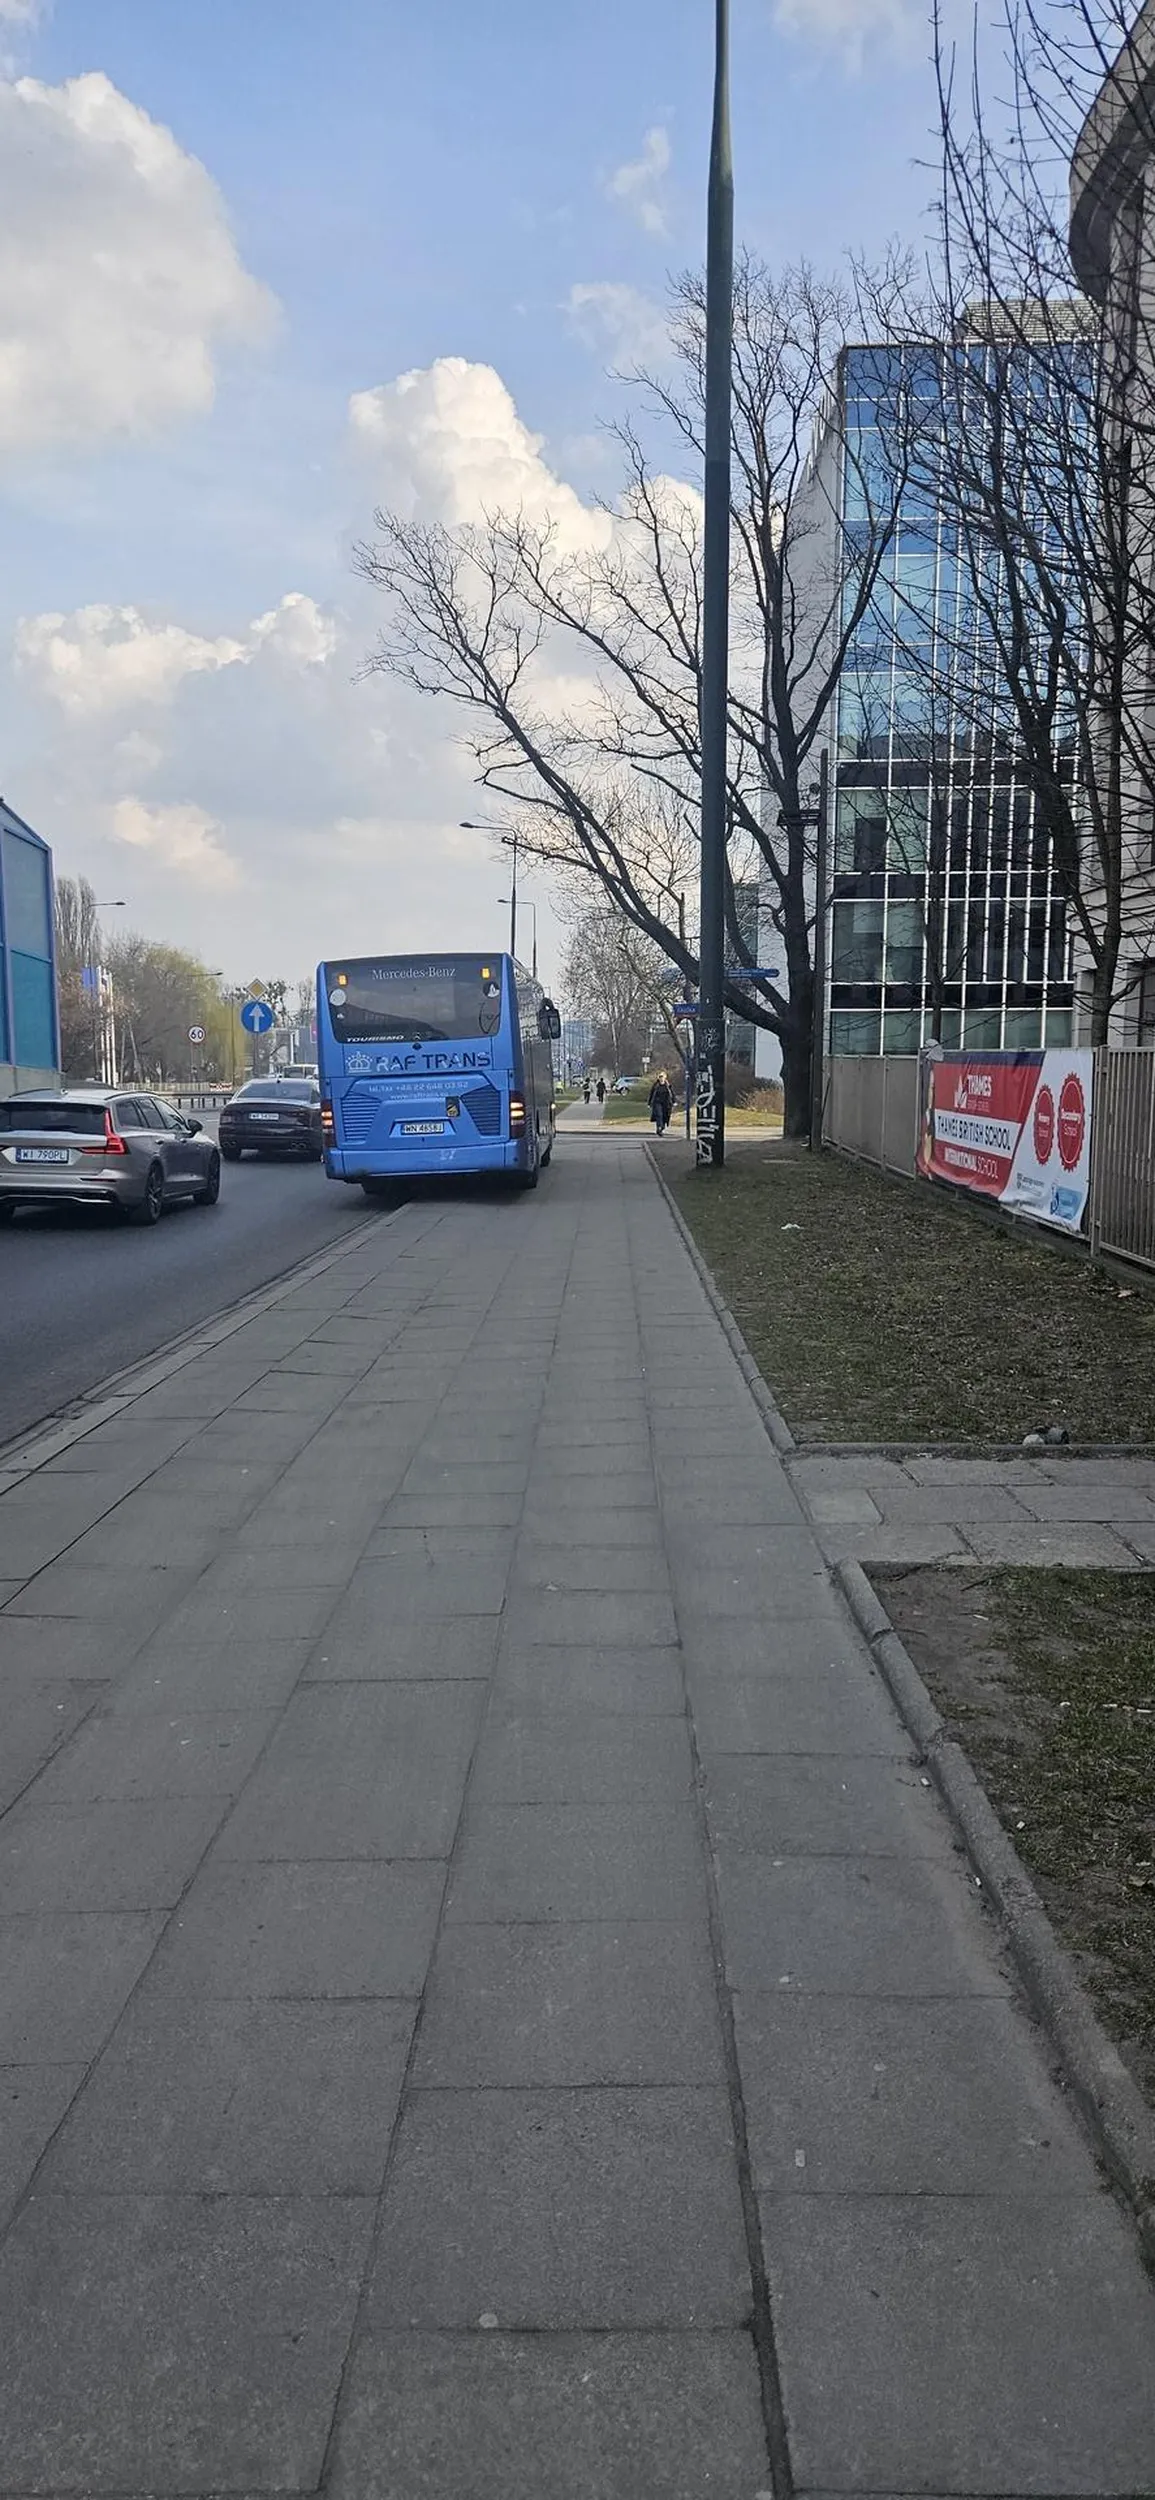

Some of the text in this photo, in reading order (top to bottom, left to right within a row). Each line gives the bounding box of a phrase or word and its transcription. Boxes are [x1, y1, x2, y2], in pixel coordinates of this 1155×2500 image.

[371, 966, 456, 981] Mercedes-Benz
[190, 1029, 204, 1040] 60
[346, 1034, 404, 1043] TOURISMO
[376, 1051, 491, 1072] RAF TRANS
[967, 1074, 992, 1097] THAMES
[938, 1115, 1011, 1151] THAMES BRITISH SCHOOL
[977, 1155, 998, 1179] SCHOOL
